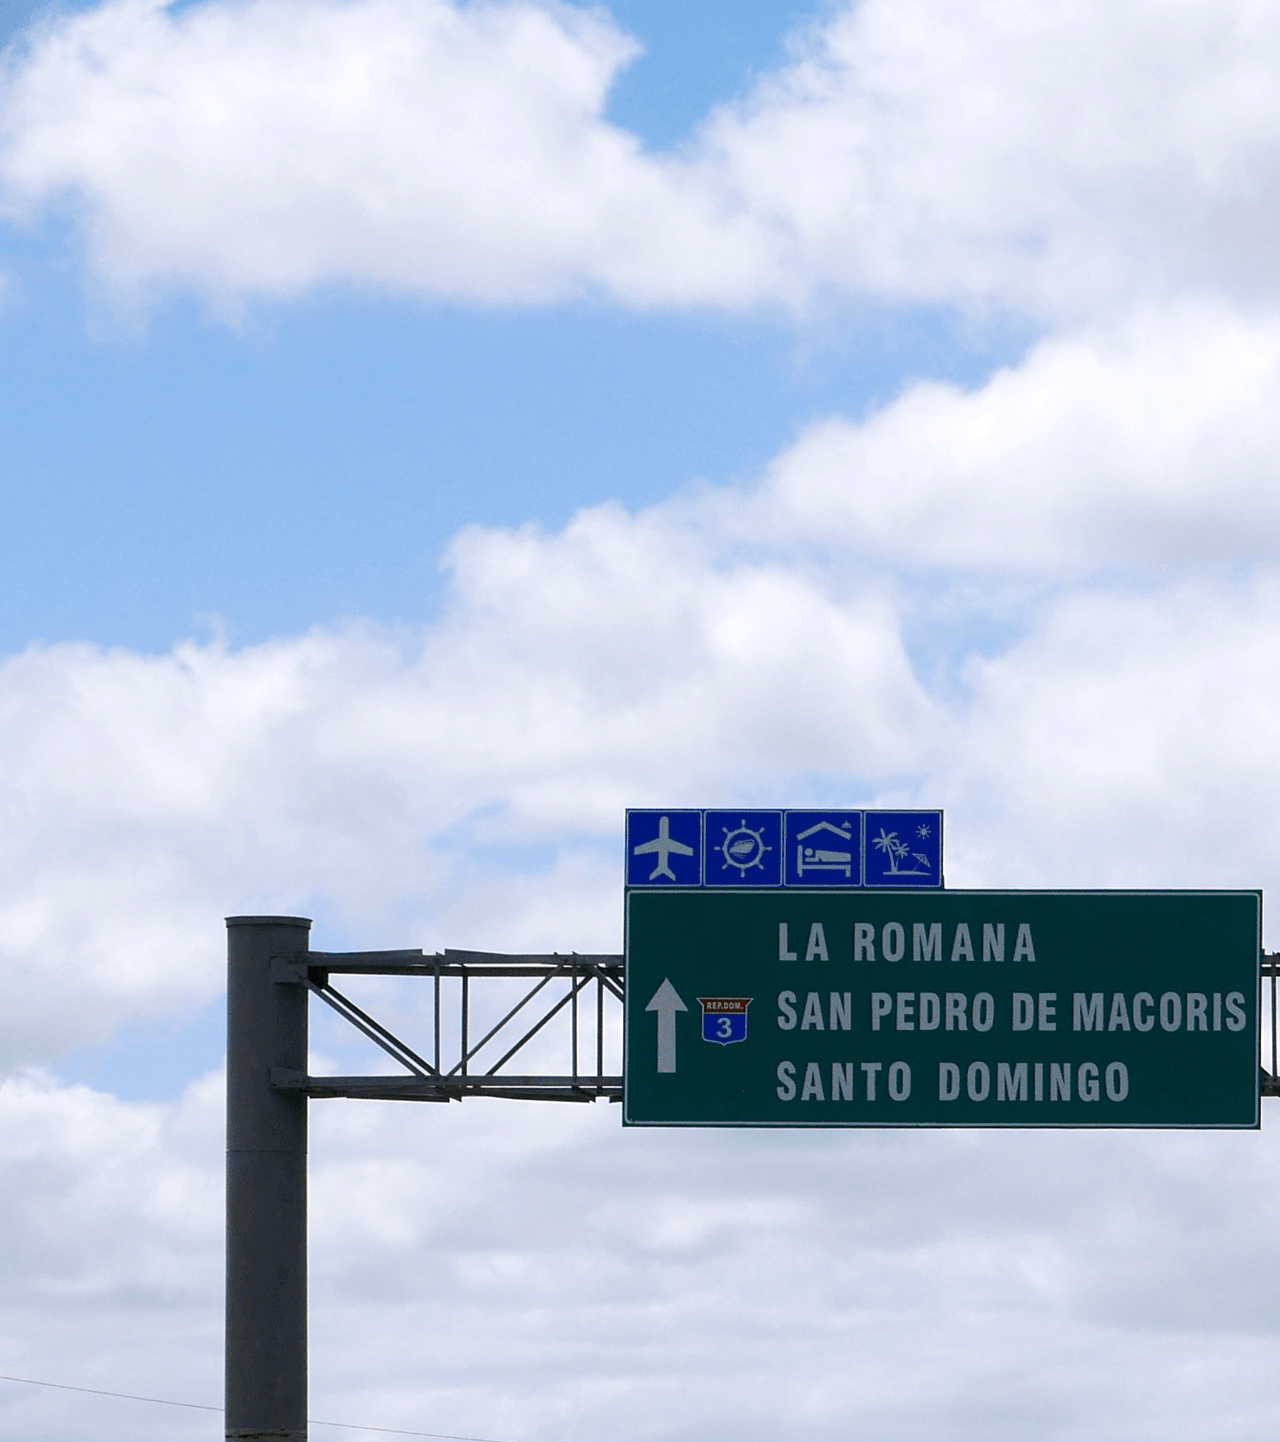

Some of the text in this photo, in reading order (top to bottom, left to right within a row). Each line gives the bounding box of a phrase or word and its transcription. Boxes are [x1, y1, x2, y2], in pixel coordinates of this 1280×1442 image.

[777, 922, 1036, 962] LA ROMANA
[706, 1001, 744, 1010] REP.DOM.
[777, 991, 1246, 1032] SAN PEDRO DE MACORIS
[716, 1017, 733, 1038] 3
[777, 1060, 1129, 1102] SANTO DOMINGO
